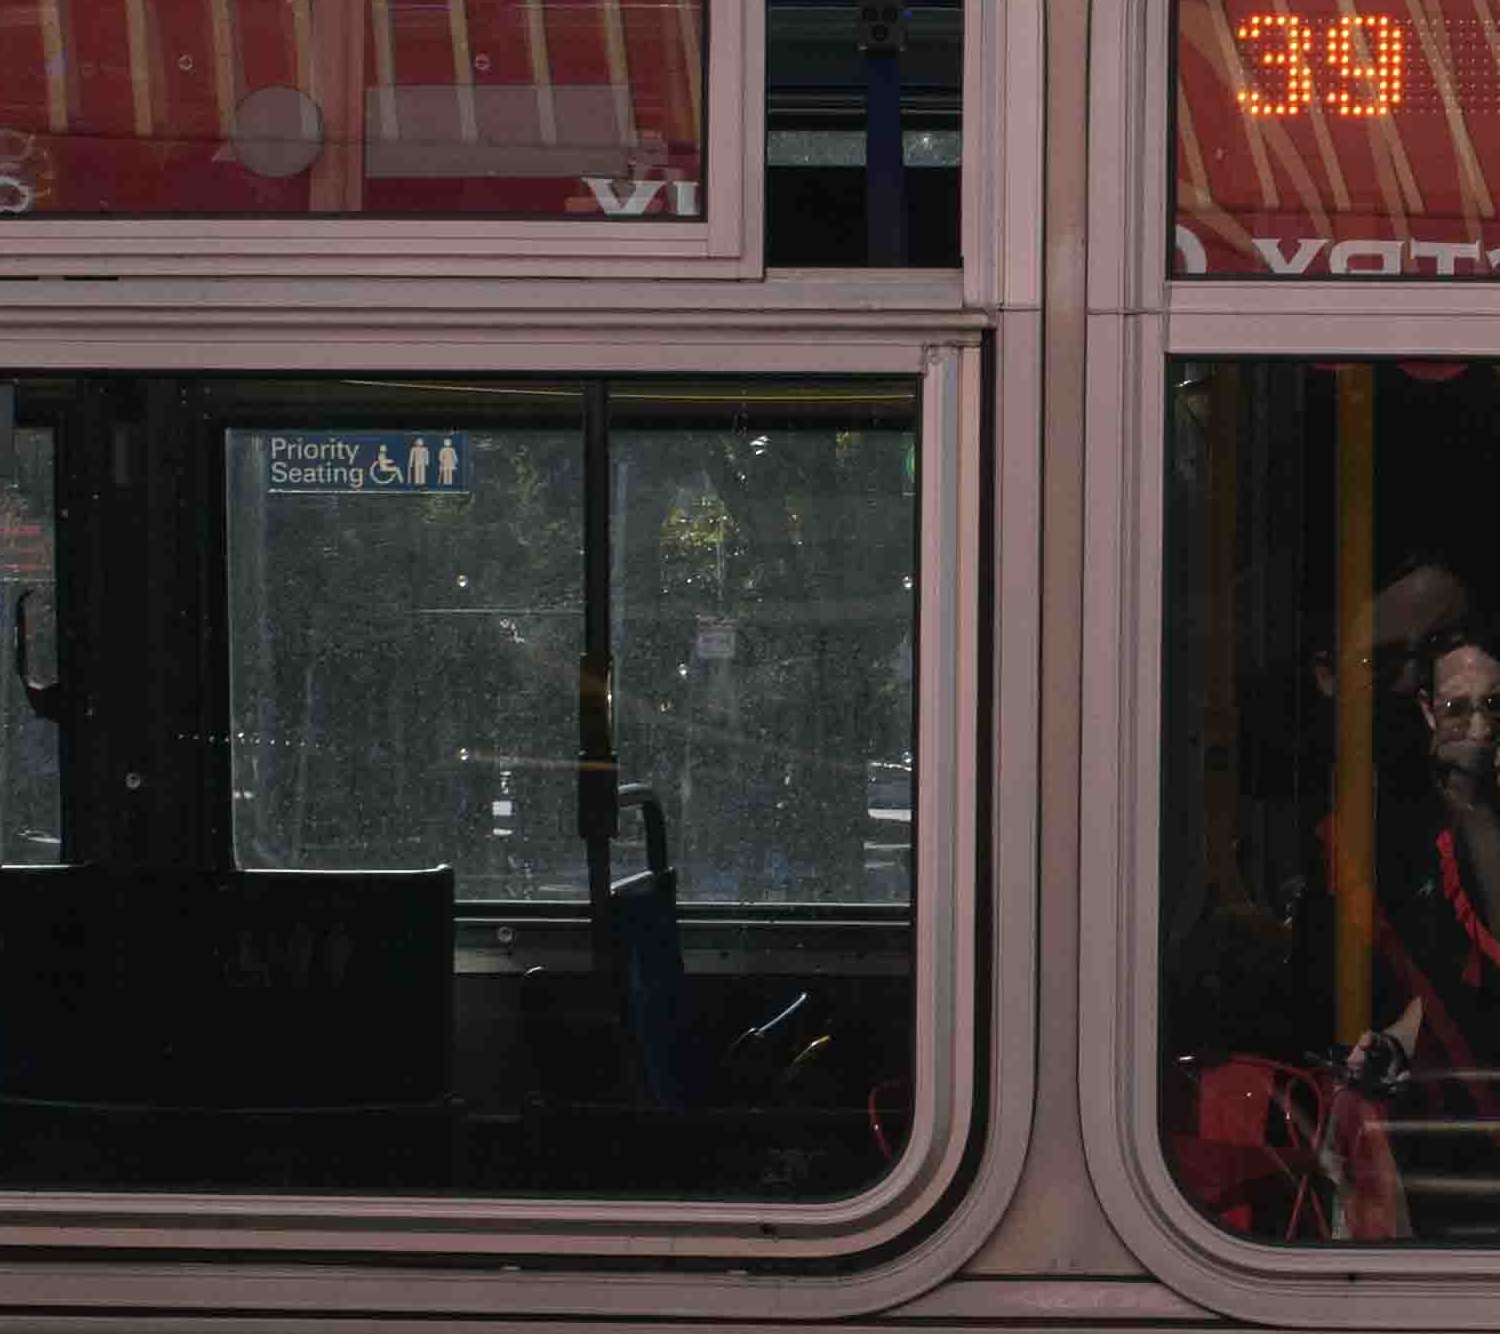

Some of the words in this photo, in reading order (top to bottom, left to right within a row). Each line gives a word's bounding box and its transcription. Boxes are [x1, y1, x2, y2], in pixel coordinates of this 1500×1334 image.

[1235, 13, 1404, 118] 39
[270, 436, 360, 466] Priority
[270, 461, 364, 488] Seating
